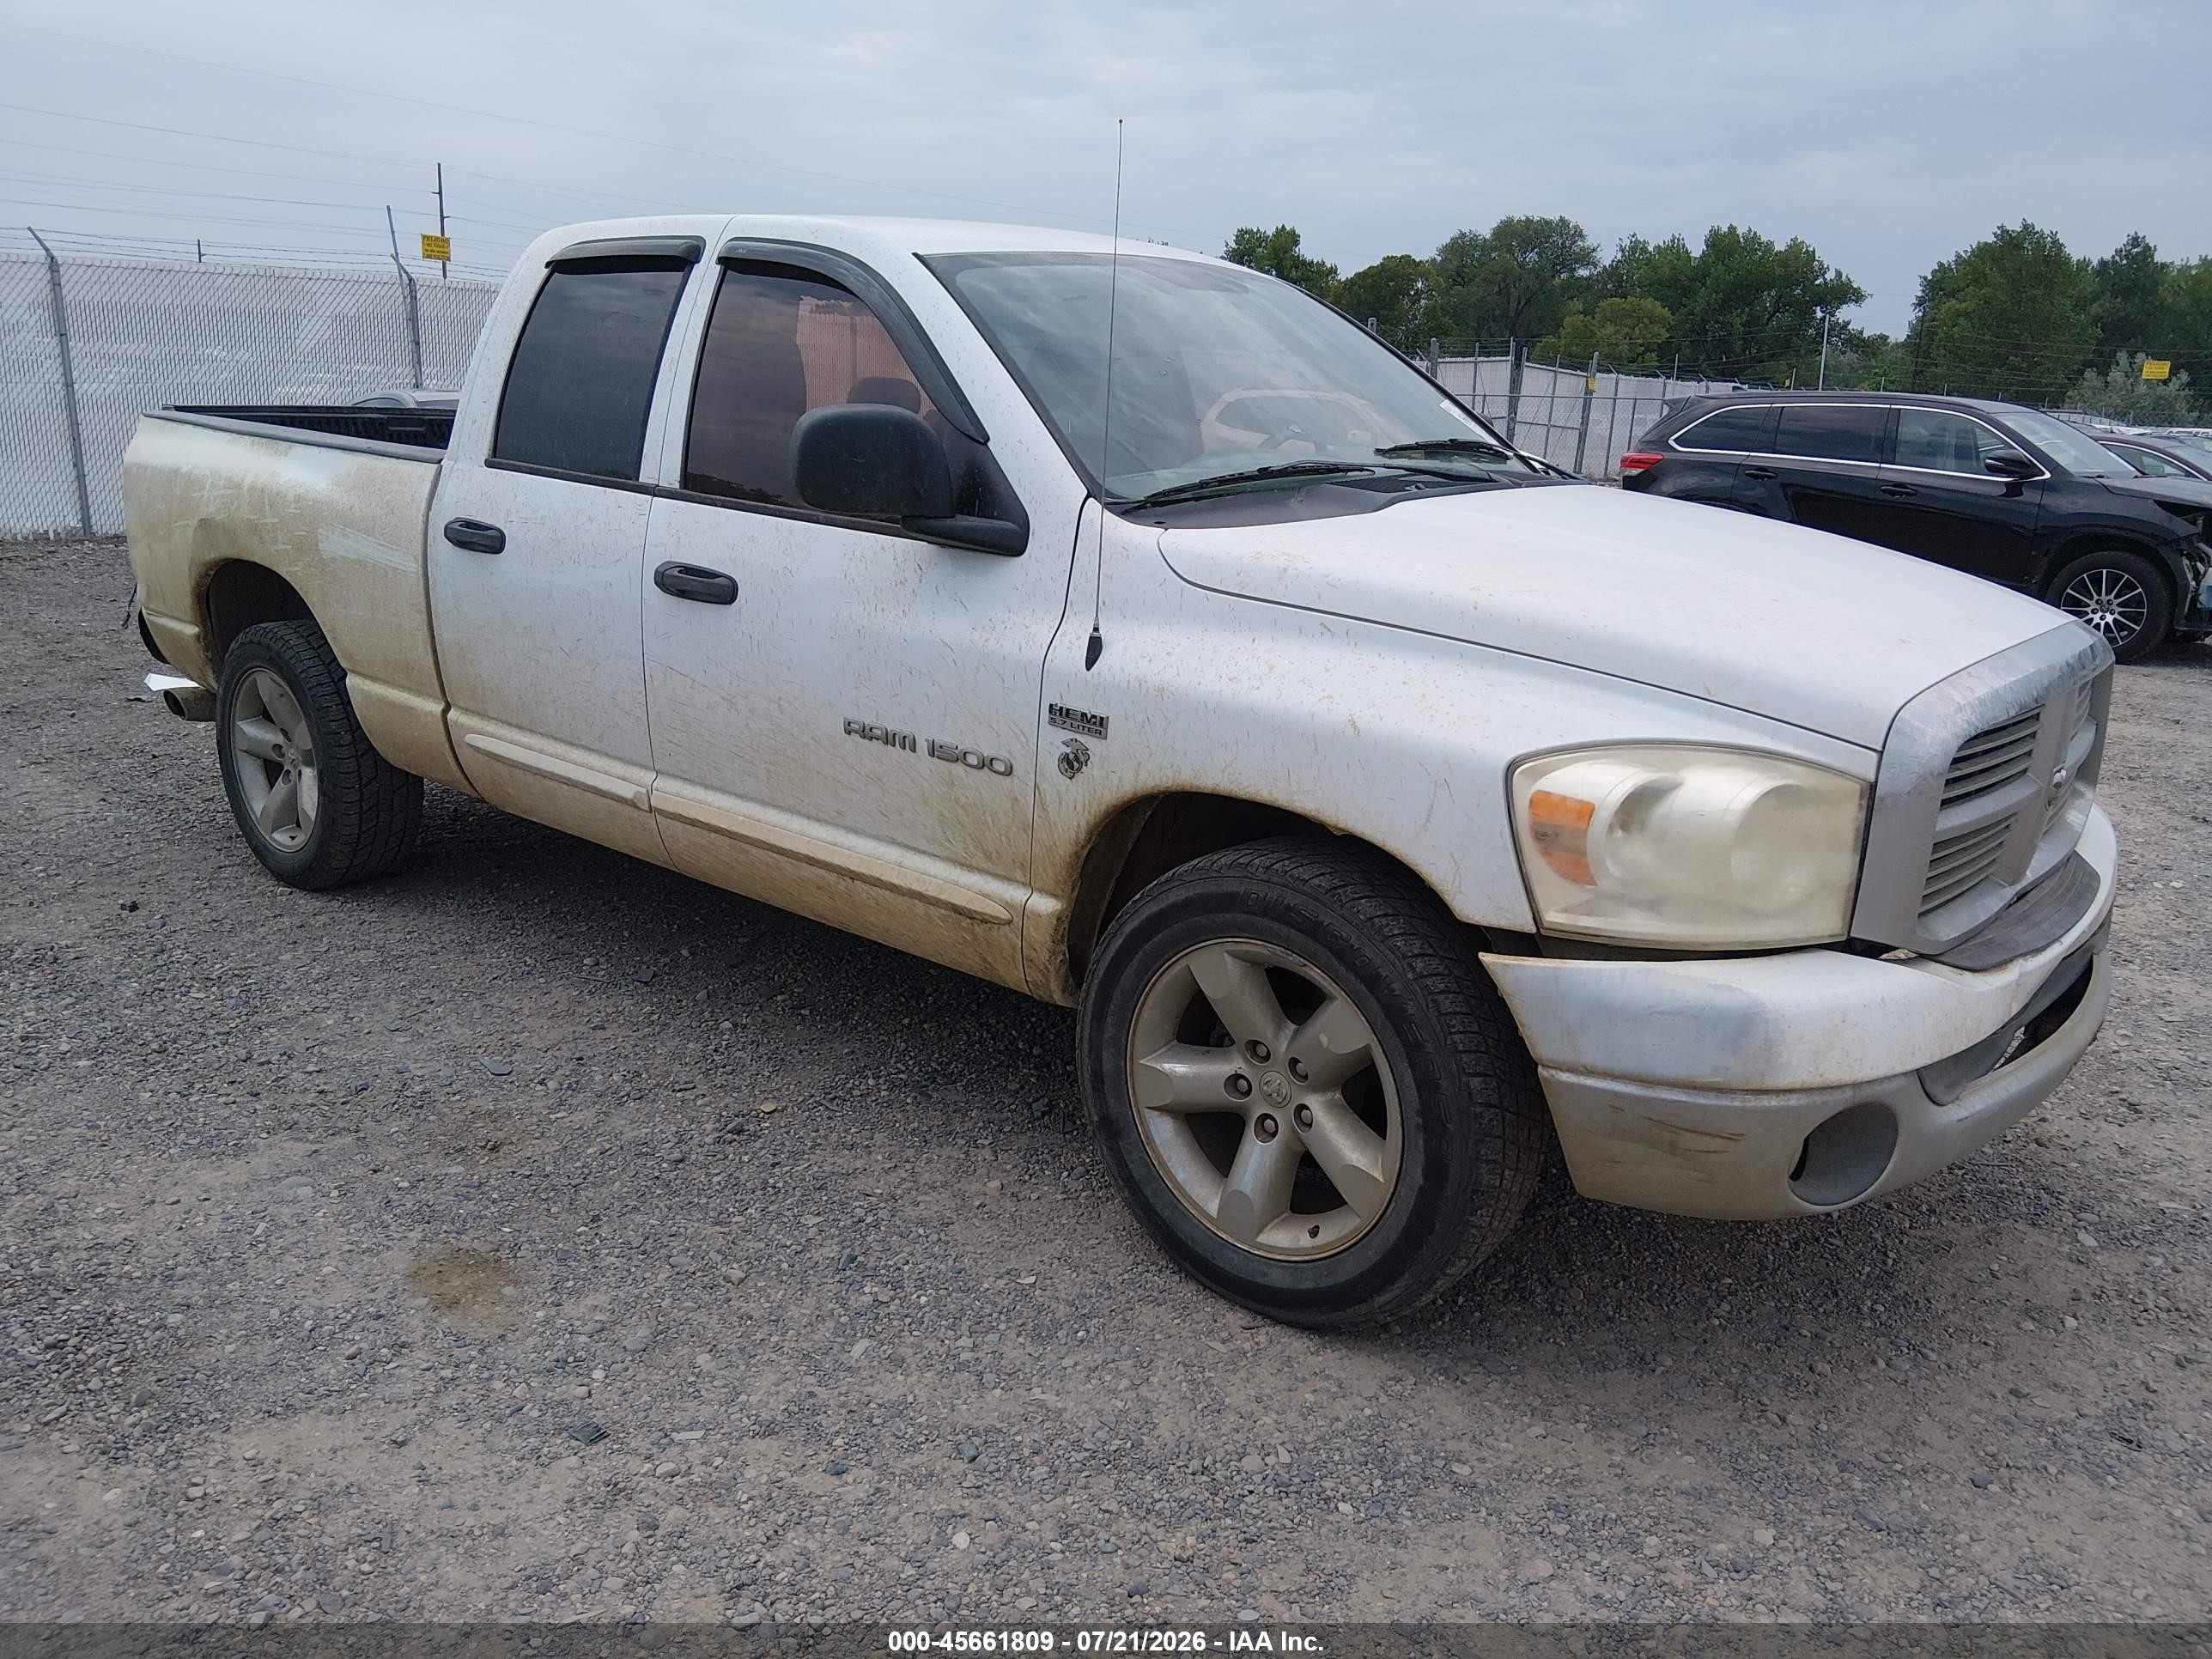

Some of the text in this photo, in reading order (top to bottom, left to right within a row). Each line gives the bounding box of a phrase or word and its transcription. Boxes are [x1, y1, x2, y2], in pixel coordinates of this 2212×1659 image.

[1048, 702, 1106, 729] HEMI
[1049, 716, 1103, 736] 5.7 LITER
[843, 716, 1013, 776] RAM 1500
